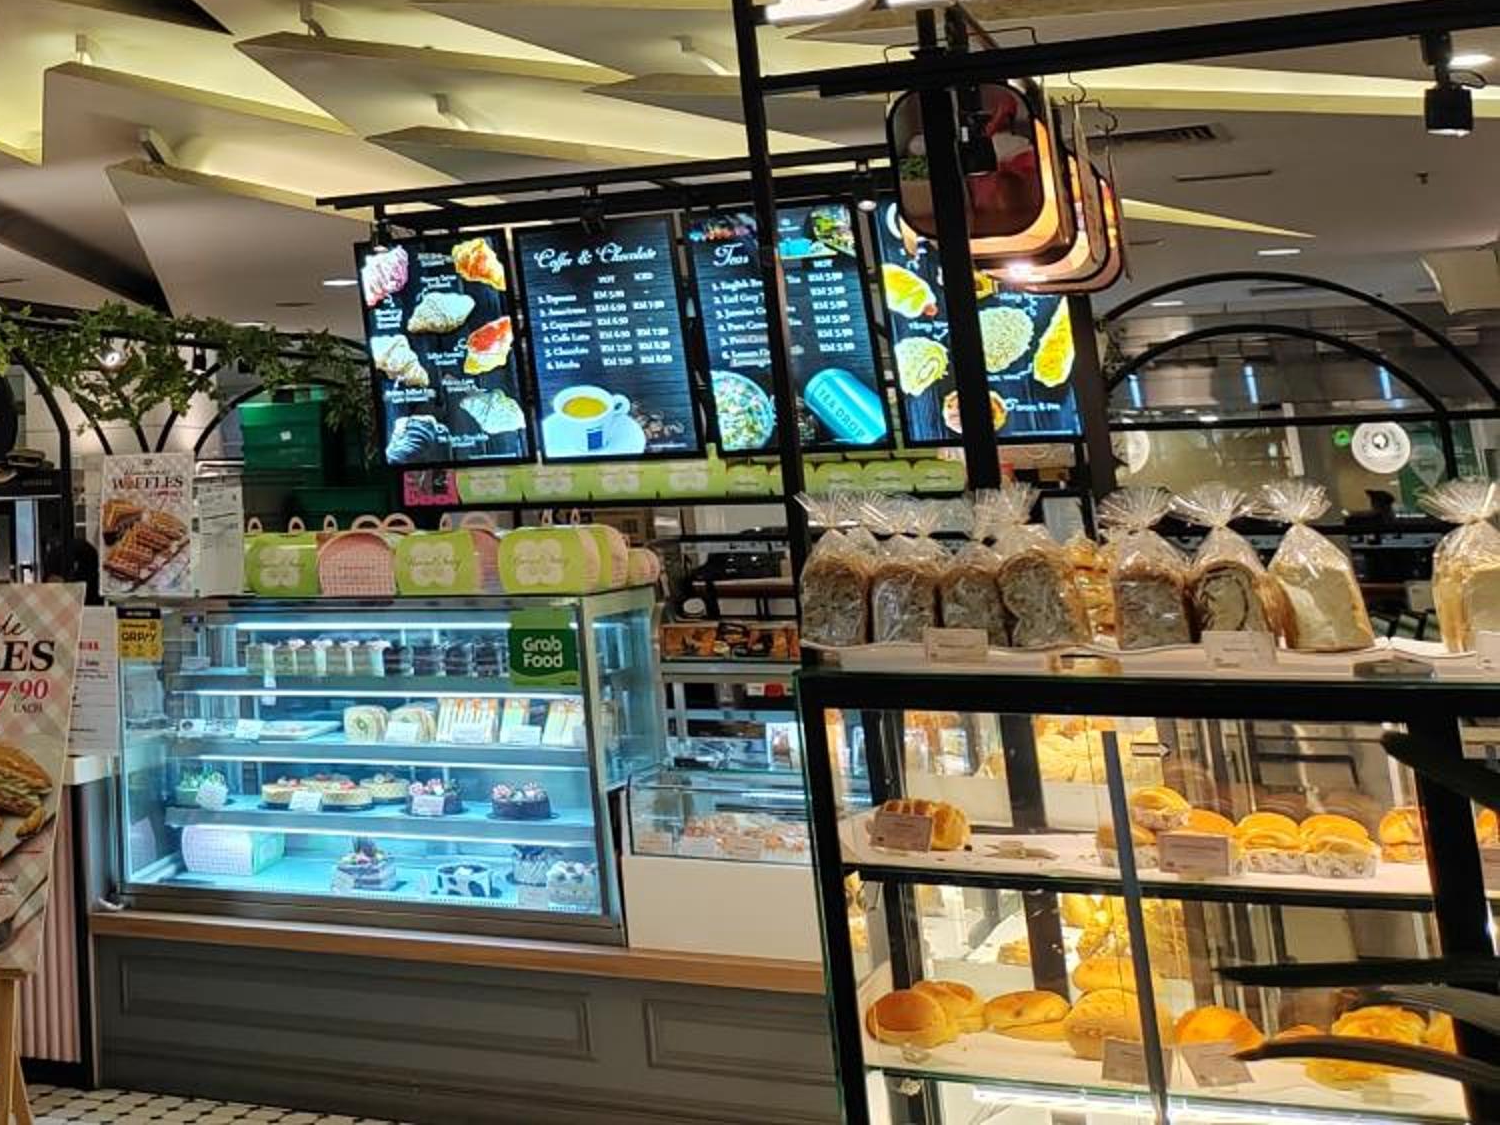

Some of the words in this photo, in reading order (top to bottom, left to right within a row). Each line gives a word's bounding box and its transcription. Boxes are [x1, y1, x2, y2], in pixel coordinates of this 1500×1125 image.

[534, 248, 573, 273] Coffee
[577, 250, 593, 265] &
[596, 242, 657, 263] Chocolate
[711, 241, 750, 267] Teas
[522, 633, 563, 652] Grab
[523, 651, 564, 668] Food
